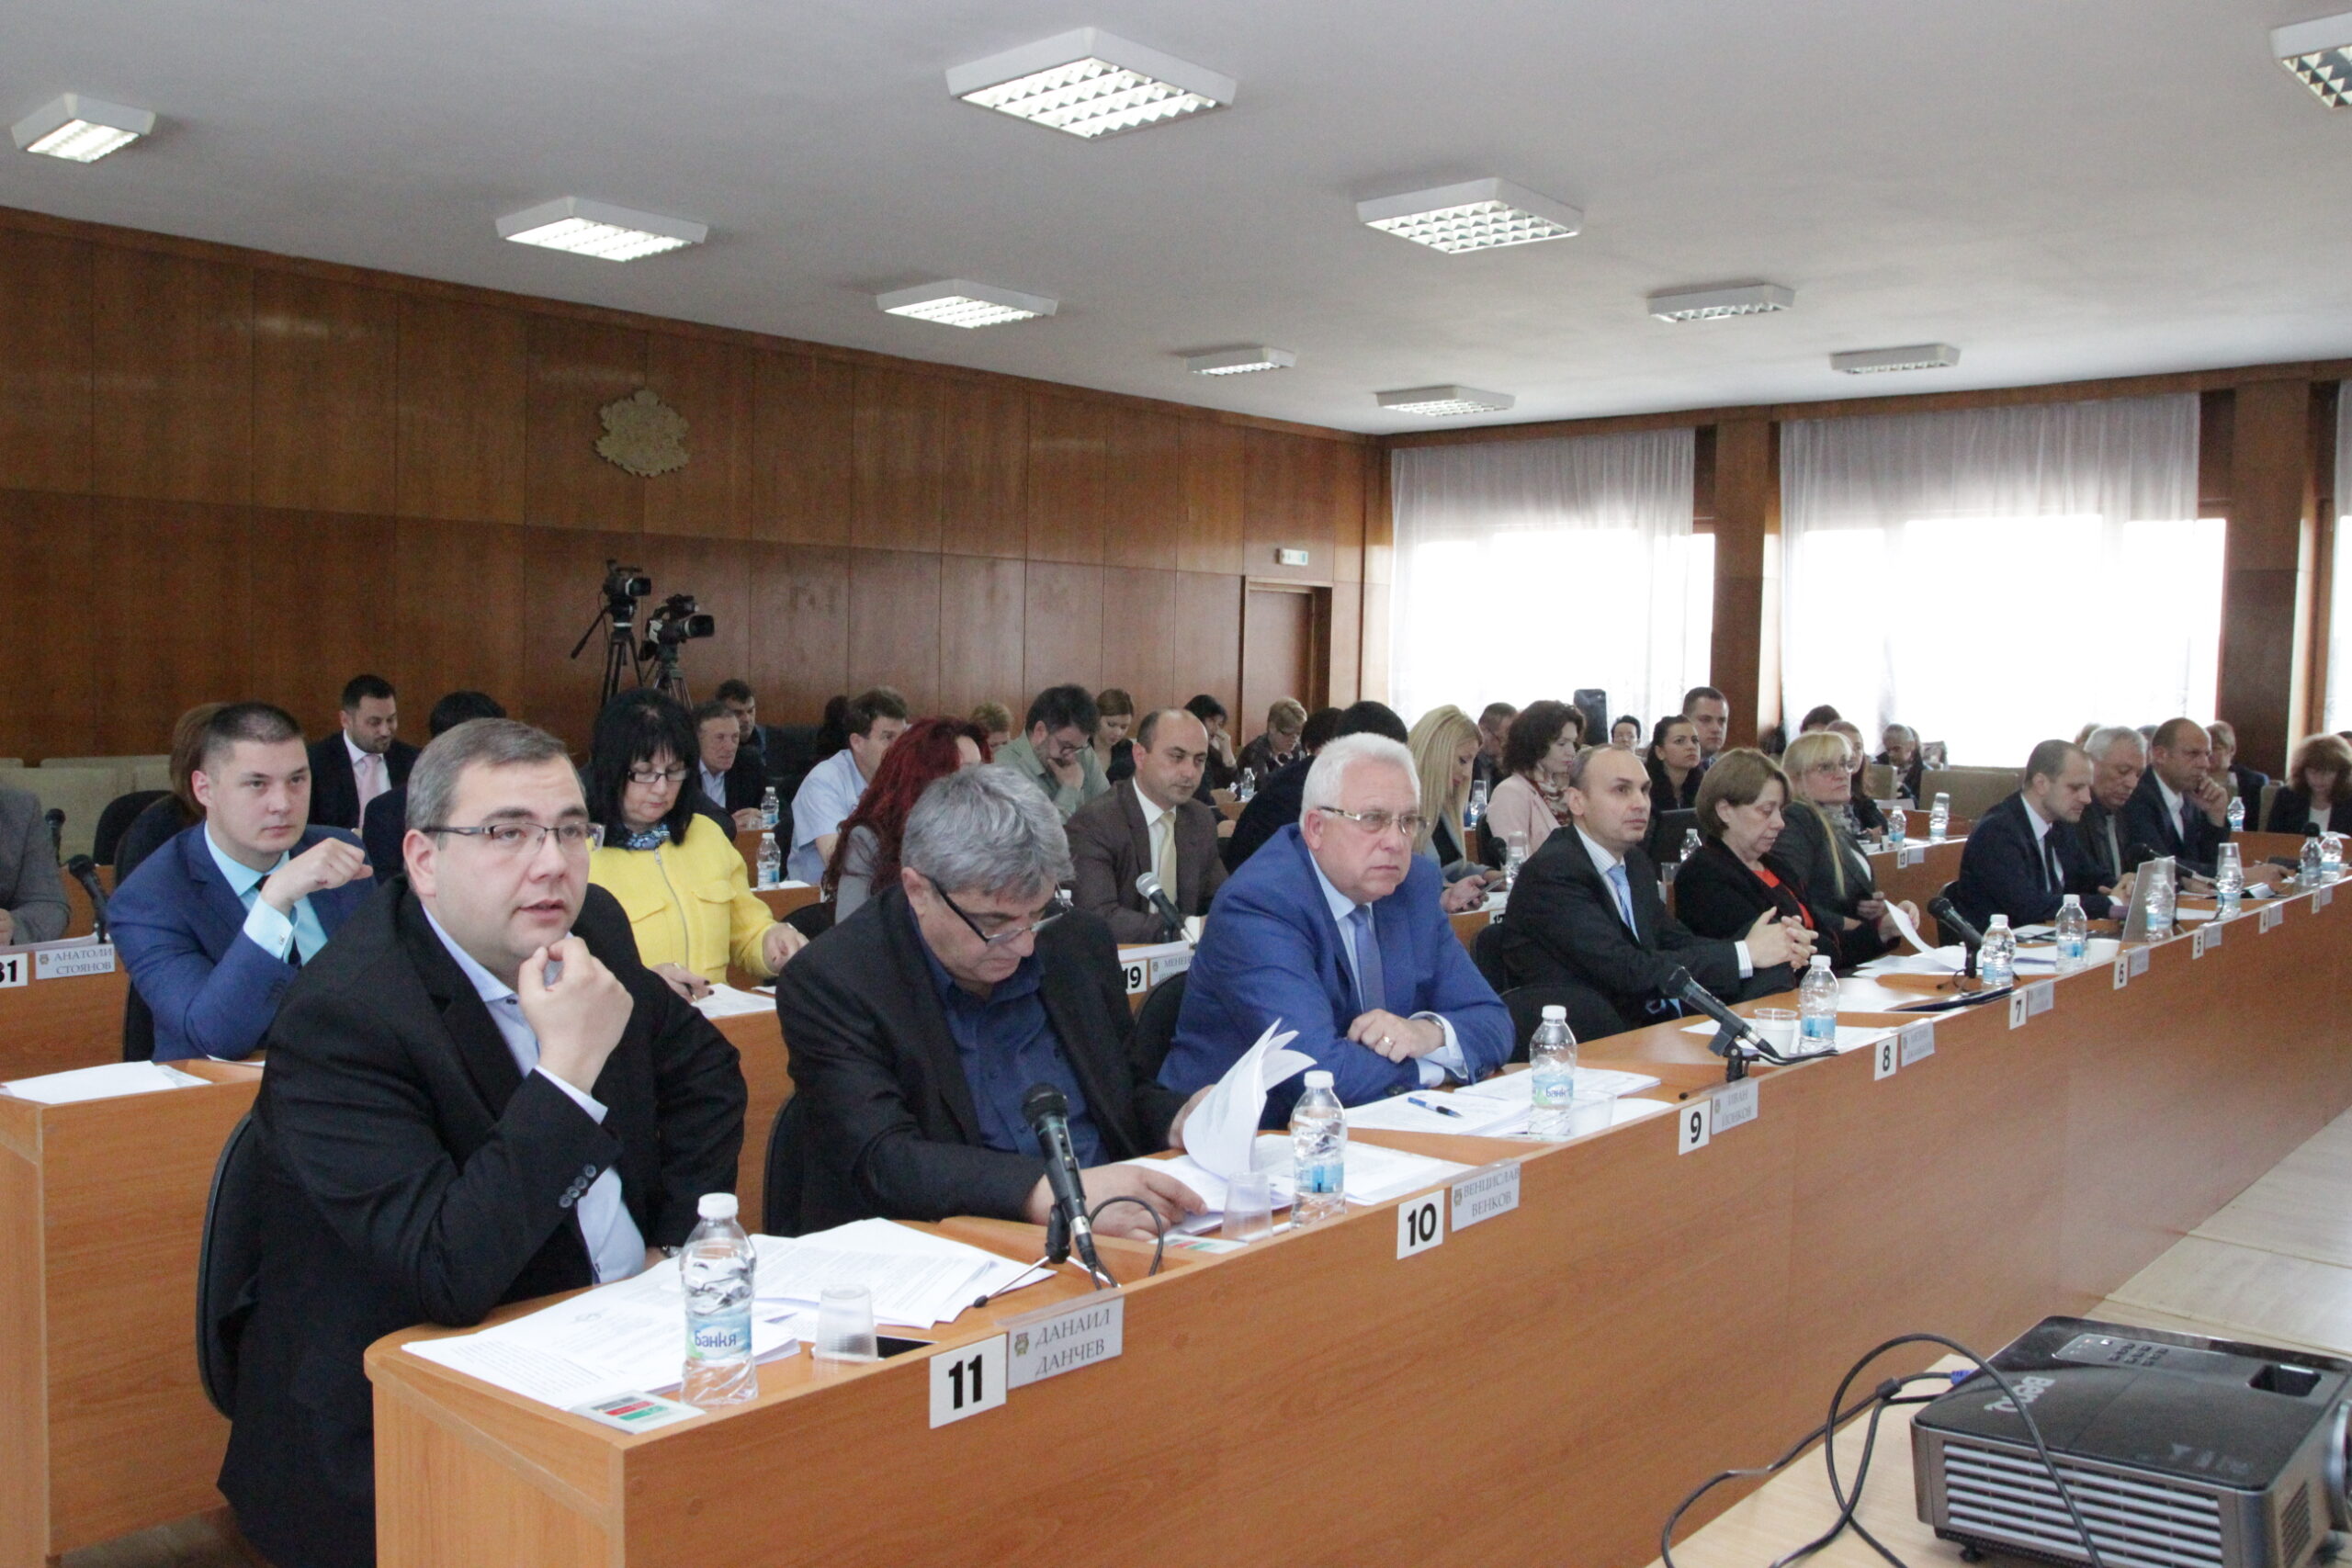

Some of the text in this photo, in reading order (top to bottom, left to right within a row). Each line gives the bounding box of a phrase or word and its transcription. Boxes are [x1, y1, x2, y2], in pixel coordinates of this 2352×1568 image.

[54, 947, 112, 963] АНАТОЛИ
[56, 961, 111, 975] СТОЯНОВ
[2016, 998, 2022, 1022] 7
[1883, 1044, 1891, 1072] 8
[1690, 1111, 1702, 1144] 9
[1463, 1166, 1521, 1198] ВЕНЦИСЛАВ
[1471, 1190, 1512, 1218] ВЕНКОВ
[1407, 1201, 1437, 1247] 10
[1035, 1308, 1110, 1348] ДАНАИЛ
[1035, 1338, 1105, 1377] ДАНЧЕВ
[948, 1353, 983, 1411] 11
